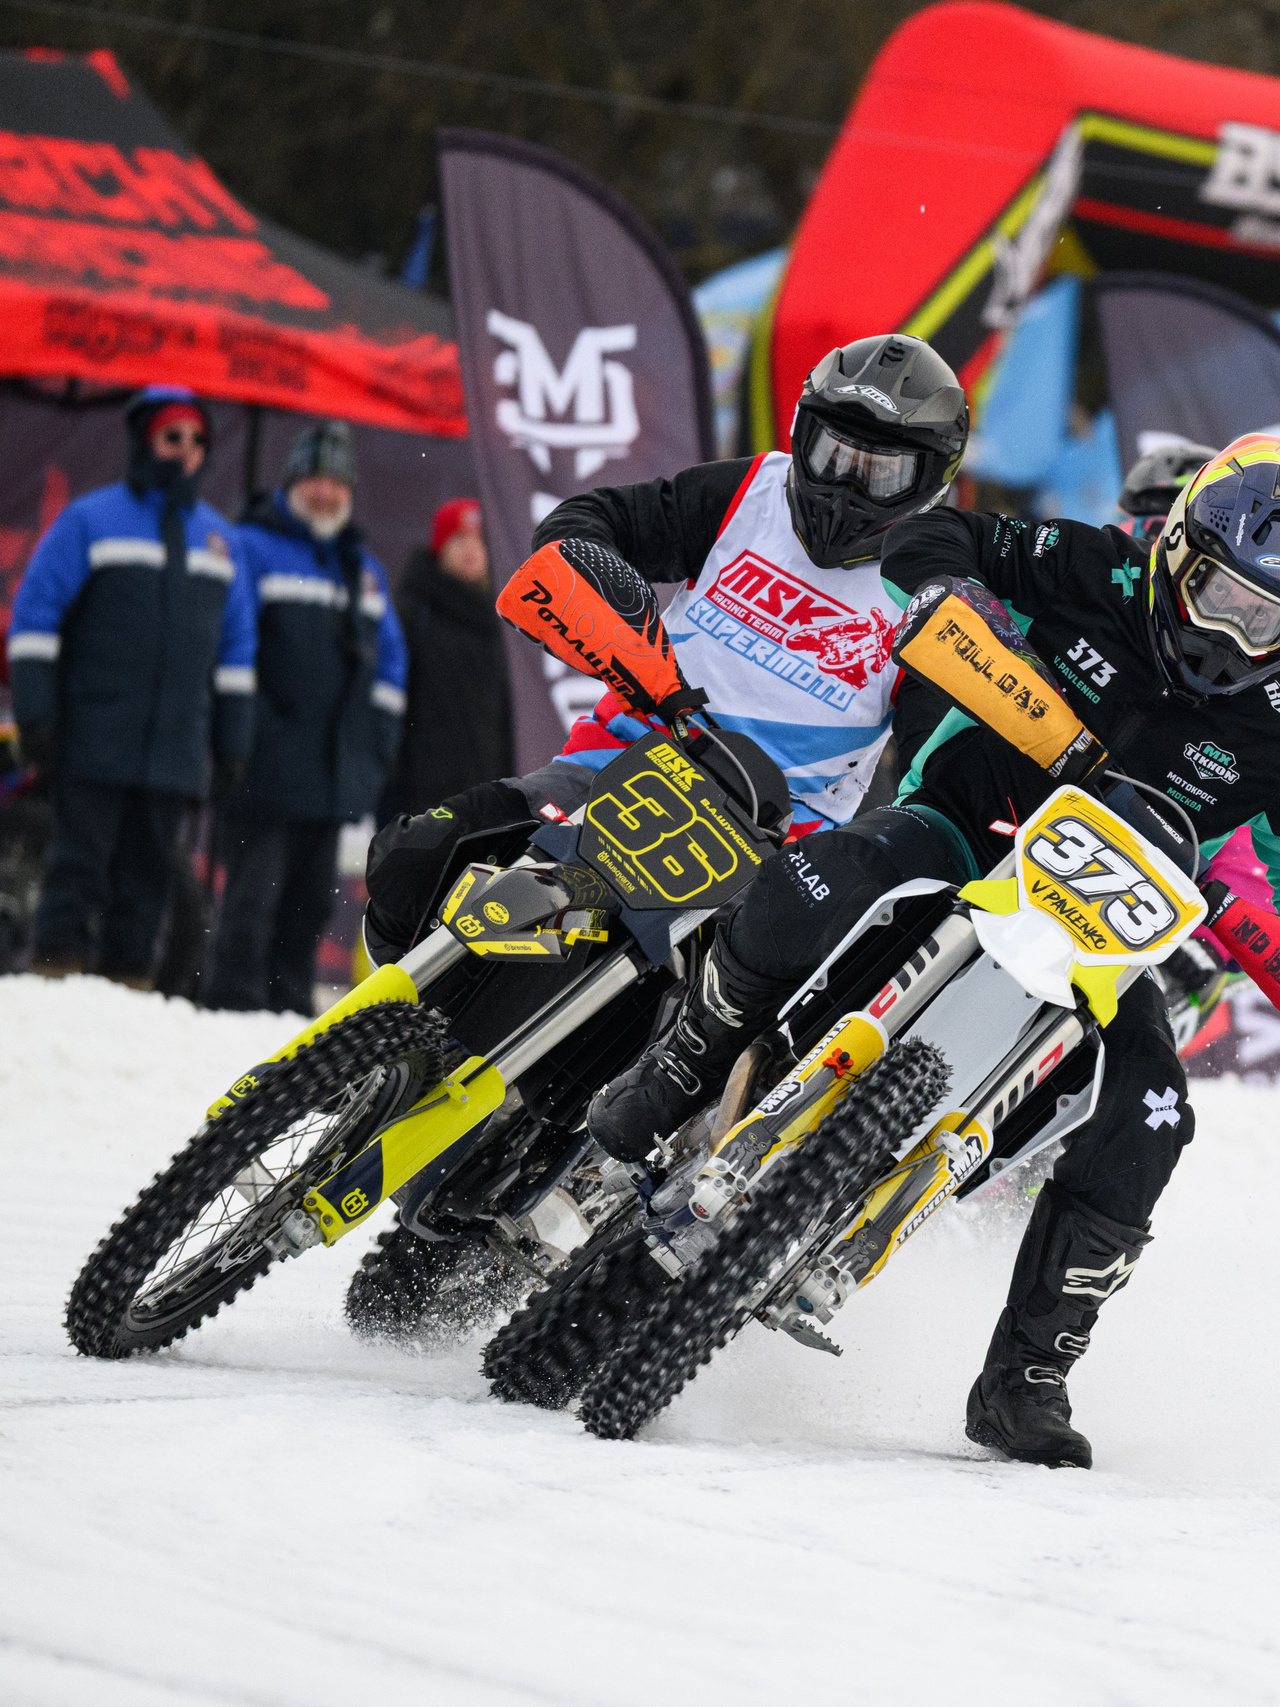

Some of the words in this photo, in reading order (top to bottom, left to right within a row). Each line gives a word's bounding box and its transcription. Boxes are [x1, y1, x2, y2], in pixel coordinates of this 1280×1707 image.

[711, 590, 748, 620] RACING
[748, 611, 784, 640] TEAM
[720, 561, 844, 626] MSK
[685, 597, 856, 713] SUPERMOTO
[935, 619, 993, 684] FULL
[997, 670, 1049, 723] GAS
[1053, 655, 1101, 705] V.PAVLENKO
[1066, 637, 1118, 689] 373
[645, 750, 670, 776] RACING
[669, 772, 691, 793] TEAM
[650, 742, 706, 788] MSK
[1186, 745, 1238, 783] TIKHON
[1203, 744, 1234, 767] MX
[1167, 771, 1217, 806] МОТОКРОСС
[1167, 787, 1202, 812] МОСКВА
[586, 770, 738, 902] 36
[604, 858, 638, 892] Husqvarna
[1029, 817, 1176, 952] 373
[1231, 914, 1271, 956] NO
[896, 1179, 957, 1245] TIKHON
